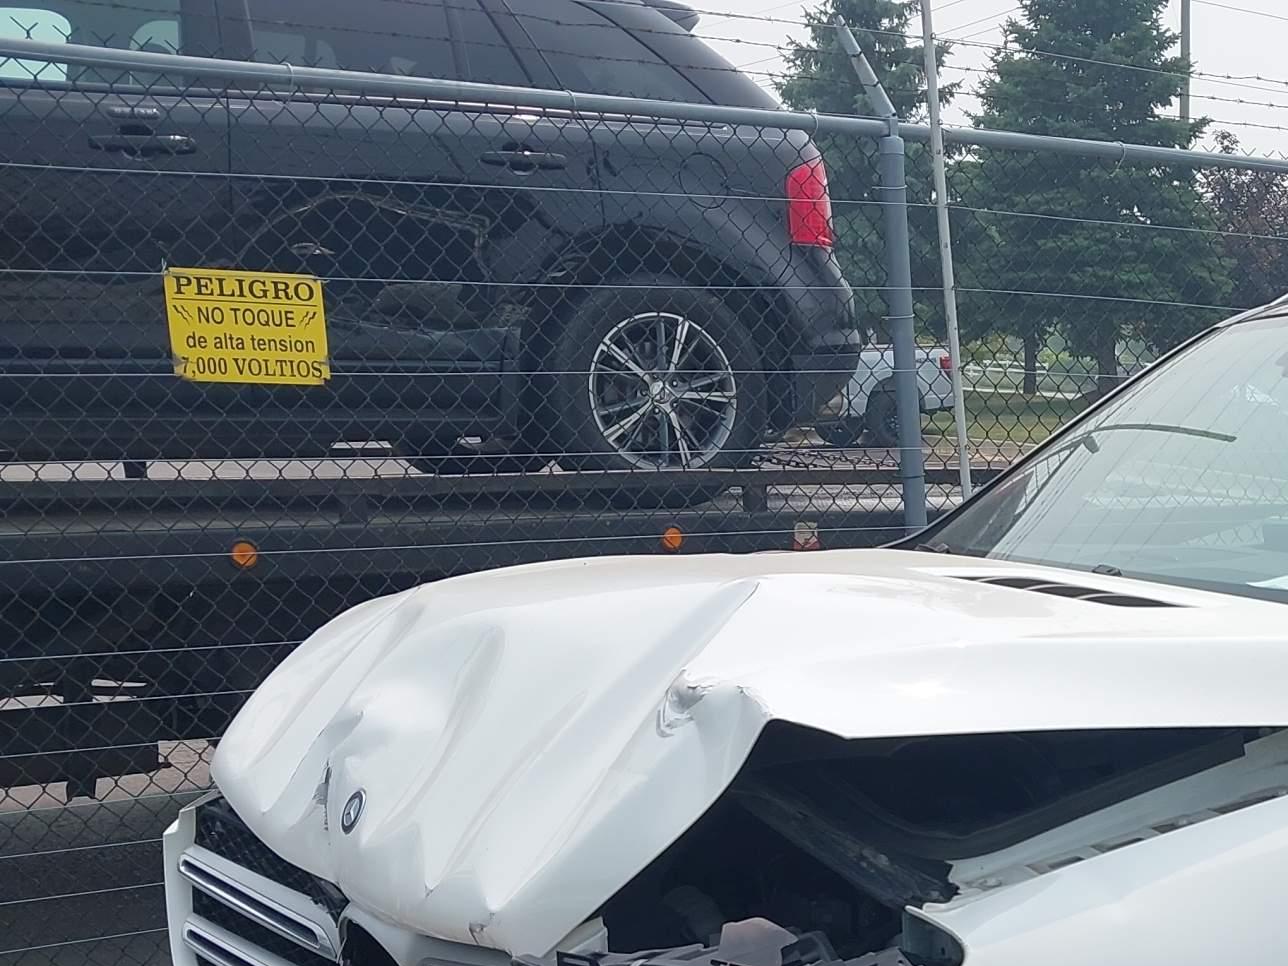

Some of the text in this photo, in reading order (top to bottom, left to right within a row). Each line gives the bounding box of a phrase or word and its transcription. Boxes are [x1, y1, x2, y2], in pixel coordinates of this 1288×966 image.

[175, 275, 314, 301] PELIGRO
[197, 306, 296, 328] NO TOQUE
[186, 331, 315, 353] de alta tension
[181, 356, 323, 379] 7,000 VOLTIOS
